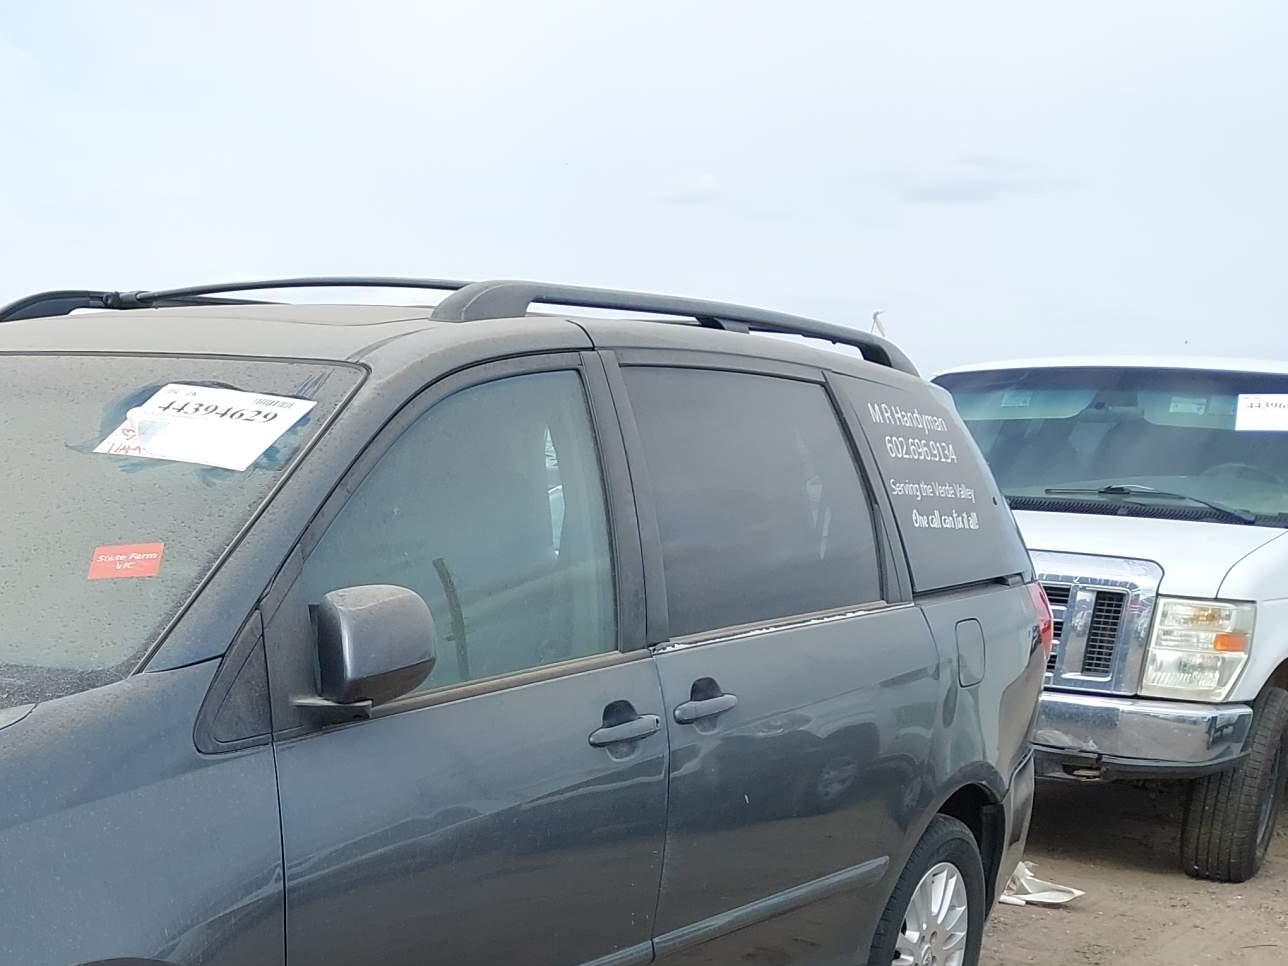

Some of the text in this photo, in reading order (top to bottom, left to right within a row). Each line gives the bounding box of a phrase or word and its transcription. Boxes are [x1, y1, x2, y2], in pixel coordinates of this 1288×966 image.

[158, 400, 279, 423] 44394629
[892, 406, 948, 435] Handyman
[885, 435, 957, 463] 602.696.9134
[890, 479, 975, 503] Serving the Verde Valley
[912, 509, 929, 528] One
[929, 510, 942, 528] call
[941, 515, 954, 528] can
[116, 561, 136, 569] VIC
[129, 552, 157, 560] Farm
